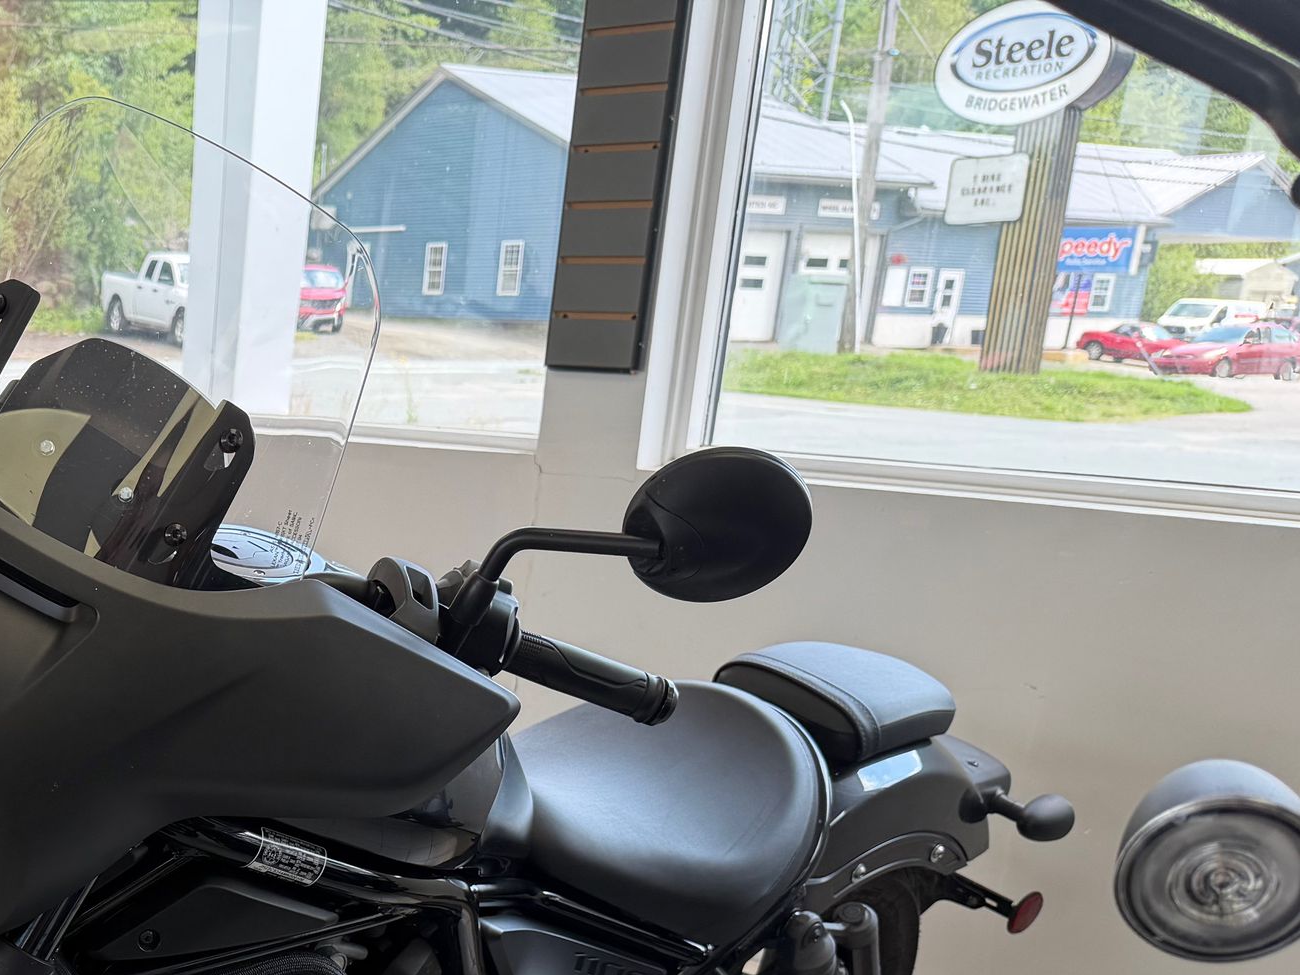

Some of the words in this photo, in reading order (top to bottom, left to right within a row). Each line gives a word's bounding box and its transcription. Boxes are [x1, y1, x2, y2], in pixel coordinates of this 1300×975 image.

[972, 29, 1074, 68] Steele
[975, 62, 1064, 81] RECREATION
[965, 83, 1068, 111] BRIDGEWATER
[1059, 234, 1132, 261] peedy
